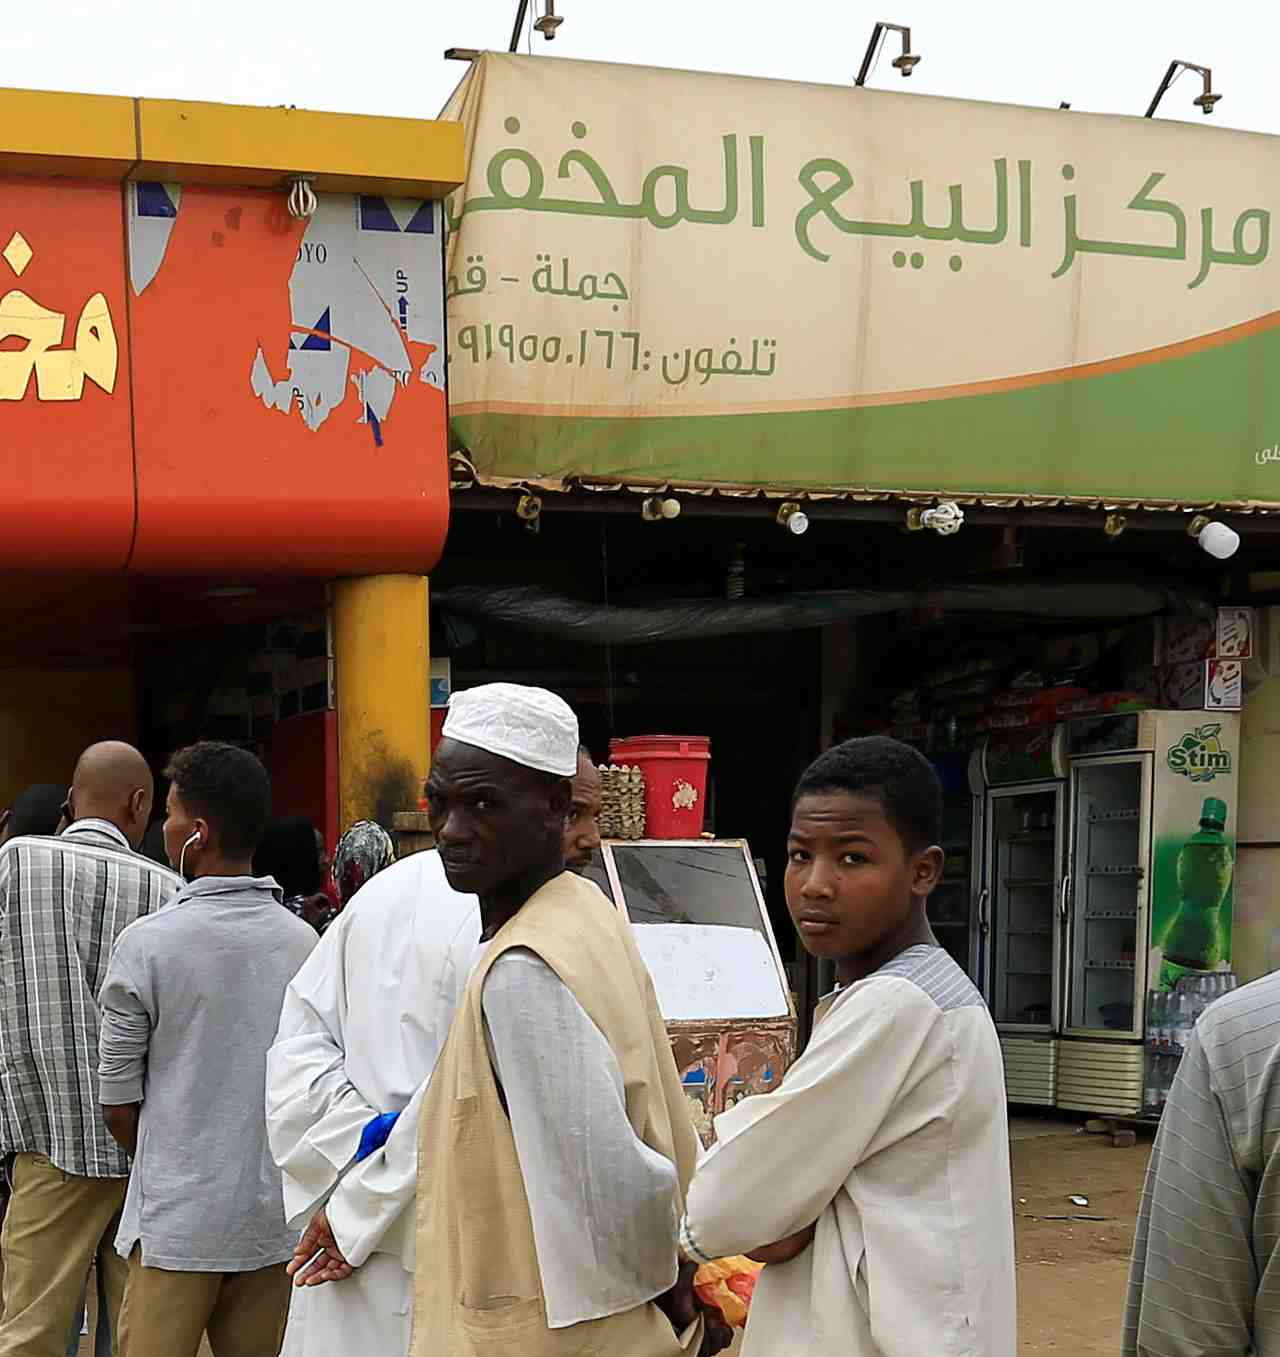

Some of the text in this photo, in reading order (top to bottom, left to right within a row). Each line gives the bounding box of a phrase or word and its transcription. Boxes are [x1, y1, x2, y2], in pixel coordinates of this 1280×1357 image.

[795, 156, 1031, 273] البيع
[1051, 163, 1270, 290] مركز
[396, 269, 408, 293] UP
[532, 254, 629, 312] جملة
[1171, 744, 1228, 767] Stim
